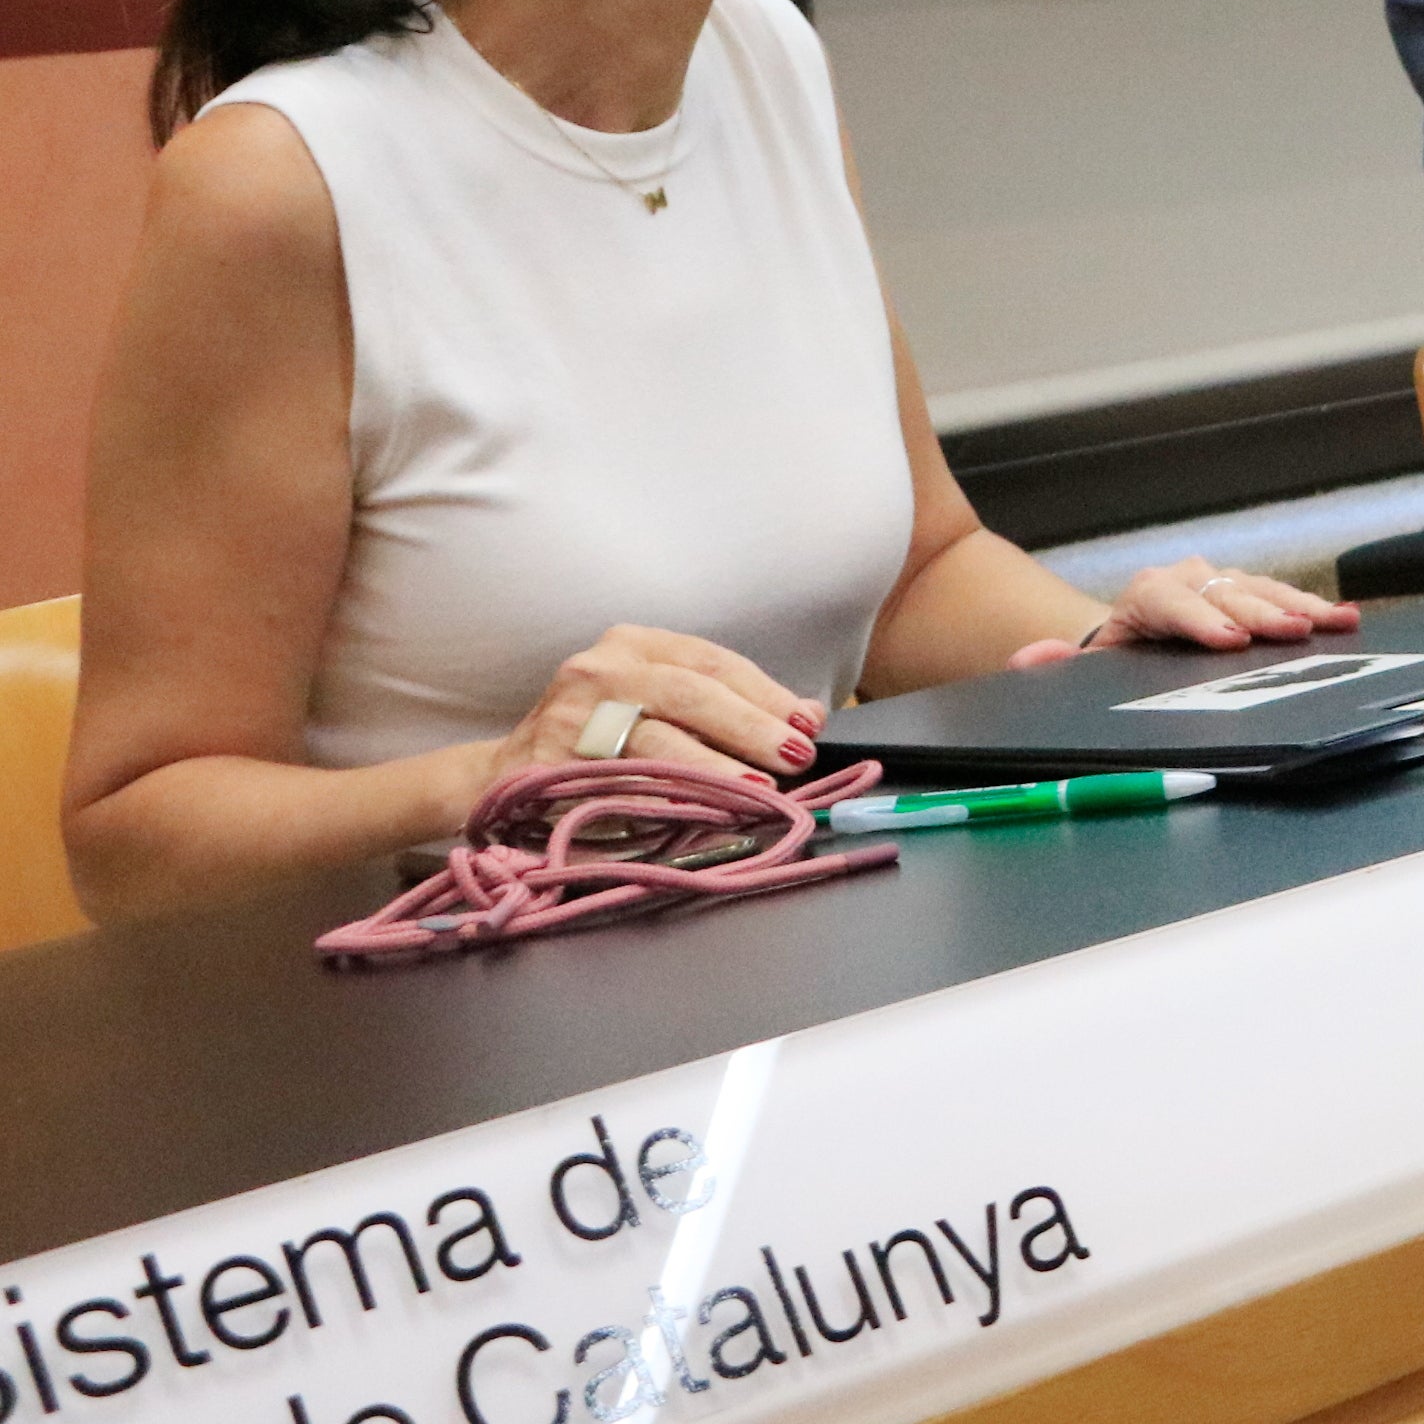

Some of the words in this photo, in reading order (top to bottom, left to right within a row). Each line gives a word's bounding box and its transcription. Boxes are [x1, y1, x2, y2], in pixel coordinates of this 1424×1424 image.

[0, 1184, 522, 1423] istema
[548, 1114, 717, 1242] de
[455, 1183, 1090, 1424] Catalunya
